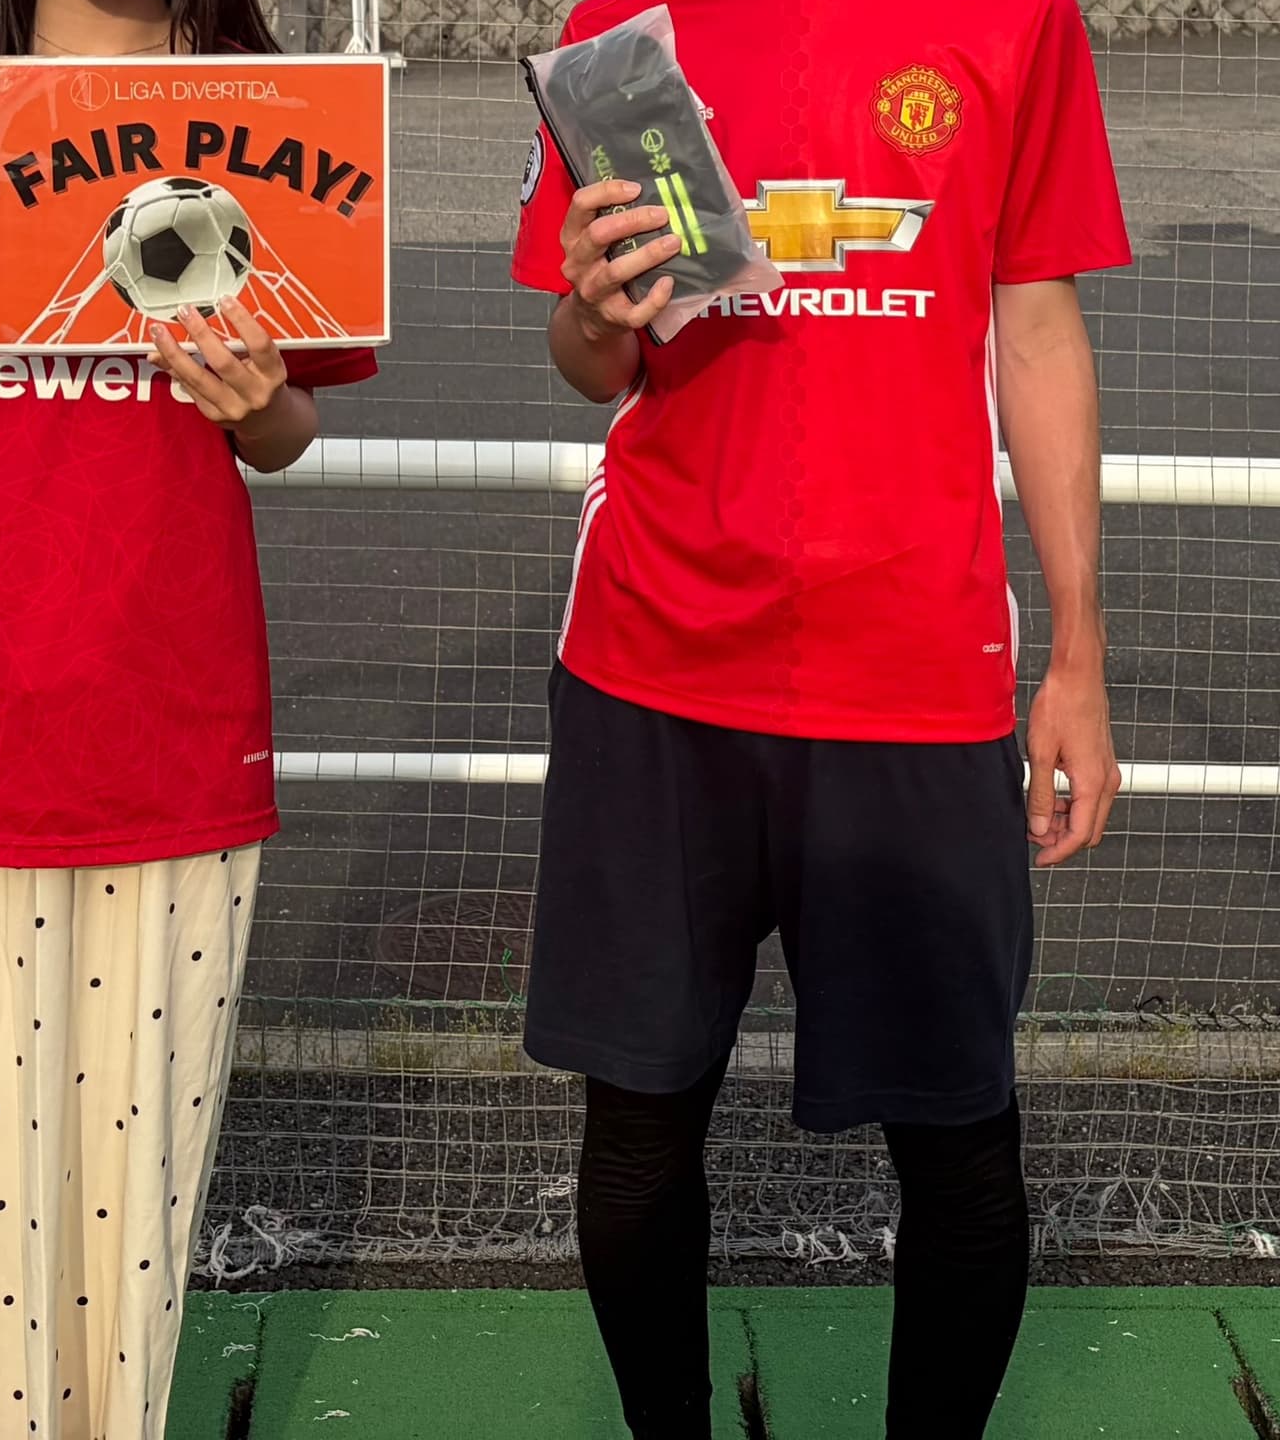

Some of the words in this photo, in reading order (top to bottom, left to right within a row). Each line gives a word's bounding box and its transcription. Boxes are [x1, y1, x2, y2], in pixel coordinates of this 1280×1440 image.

[886, 72, 952, 106] MANCHESTER
[890, 125, 937, 143] UNITED
[4, 122, 163, 209] FAIR
[184, 120, 374, 217] PLAY!
[699, 287, 936, 318] HEVROLET
